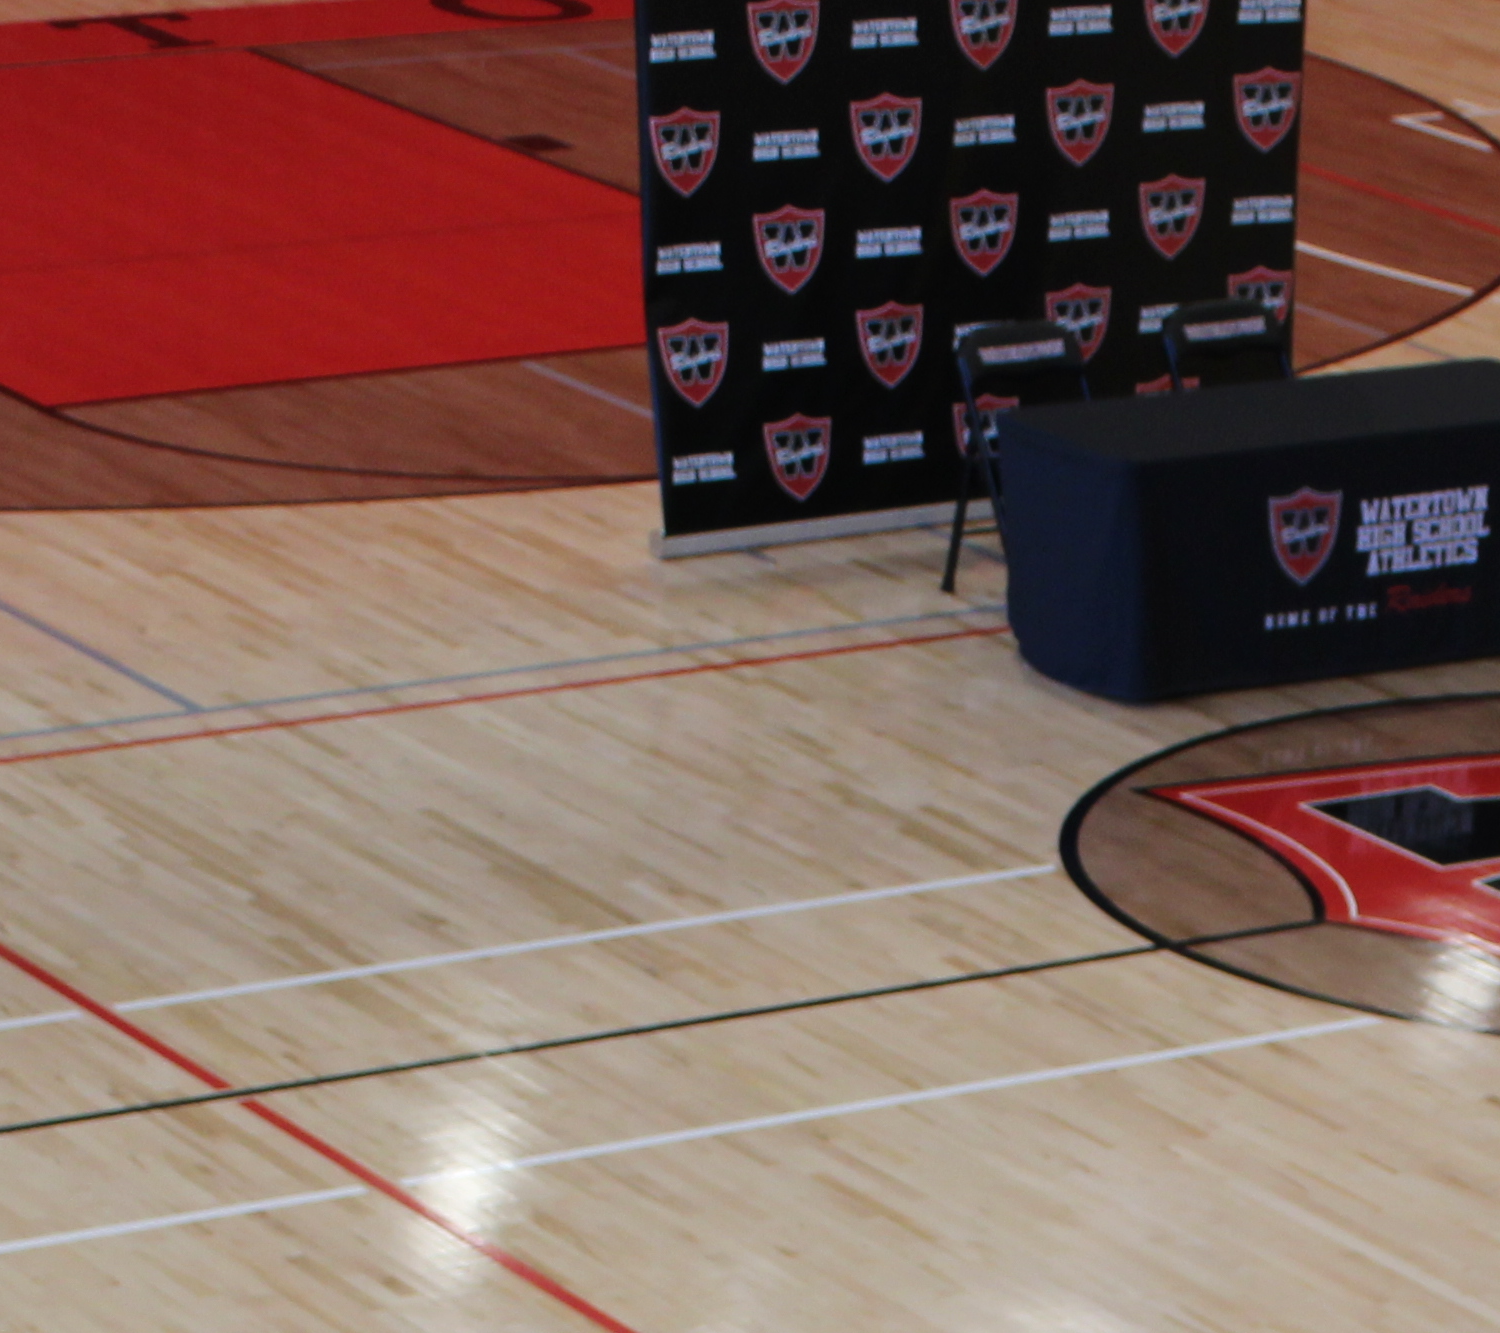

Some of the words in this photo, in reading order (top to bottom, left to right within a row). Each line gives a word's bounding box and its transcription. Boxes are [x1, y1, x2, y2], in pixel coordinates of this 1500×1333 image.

[1361, 484, 1489, 524] WATERTOWN
[1356, 520, 1408, 553] HIGH
[1411, 511, 1491, 546] SCHOOL
[1366, 538, 1479, 578] ATHLETICS
